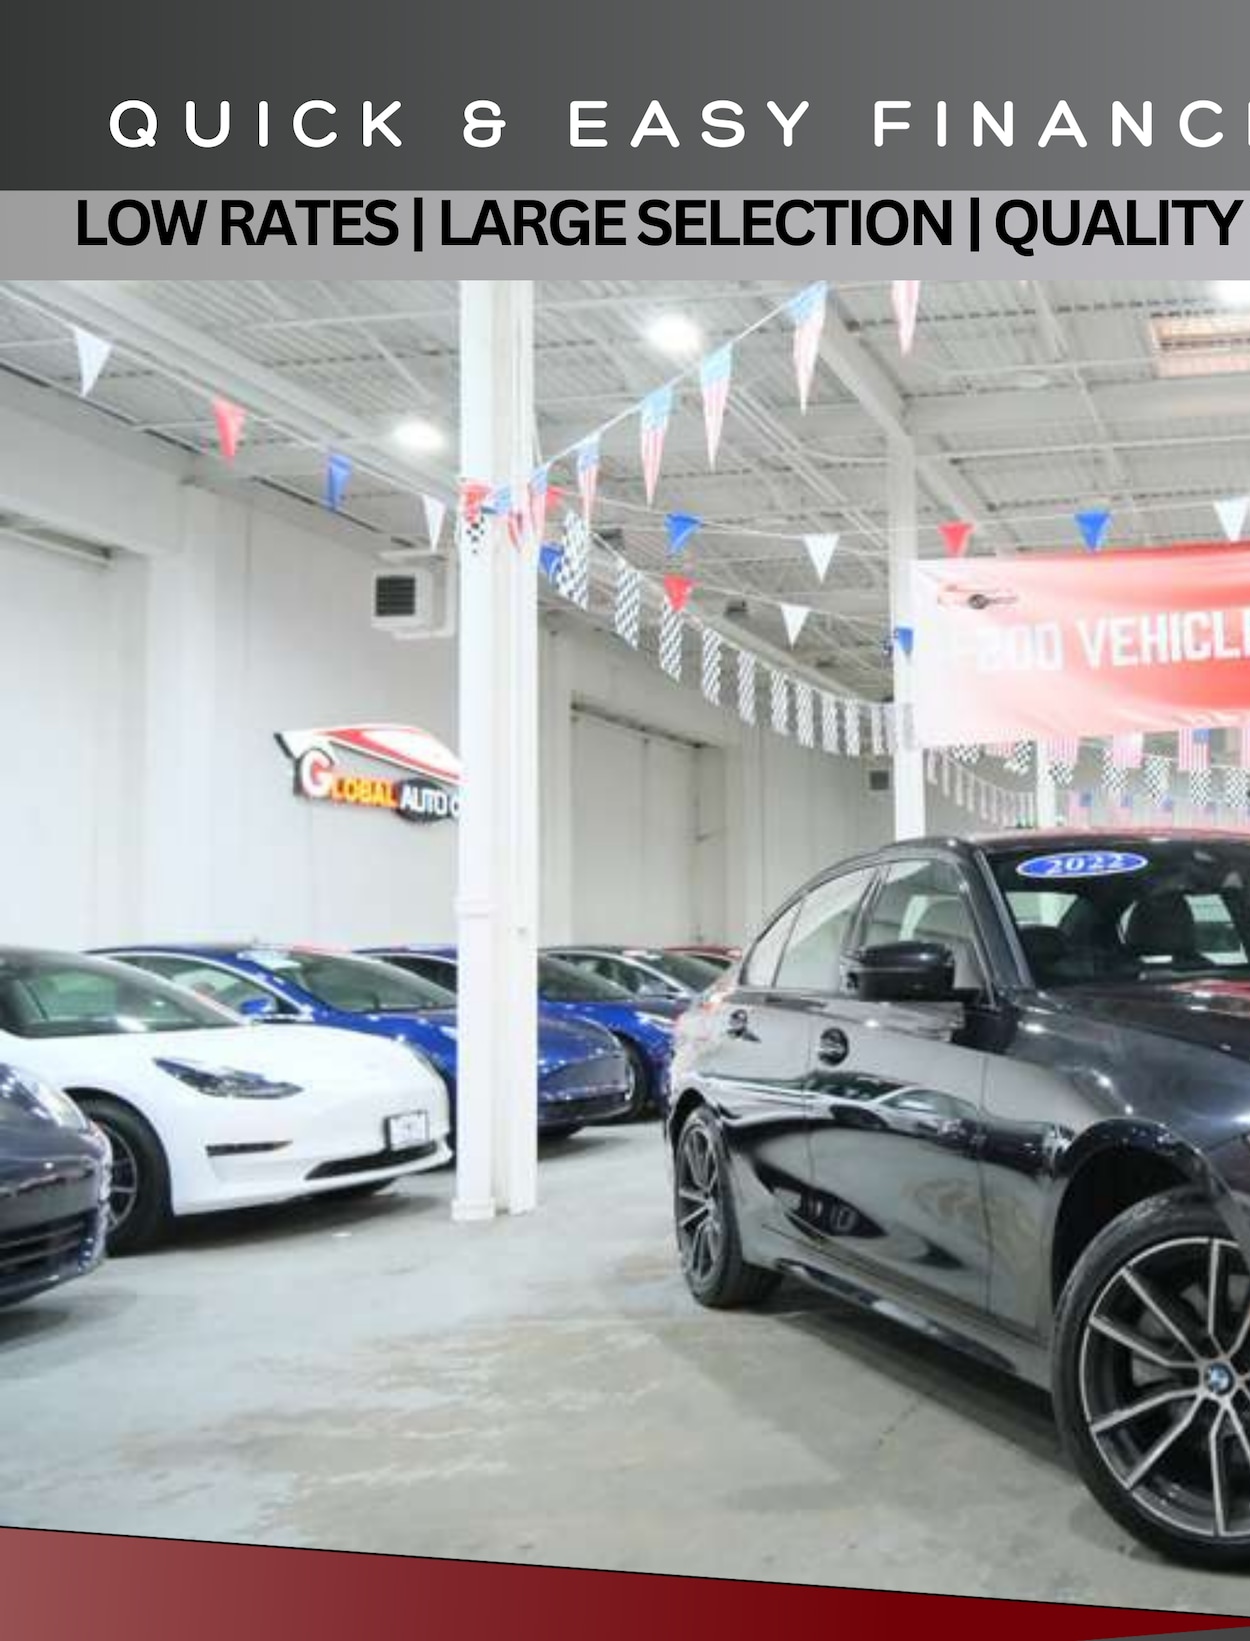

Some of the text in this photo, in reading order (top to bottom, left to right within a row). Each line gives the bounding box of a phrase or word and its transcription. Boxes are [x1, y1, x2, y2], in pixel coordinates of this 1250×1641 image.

[301, 749, 398, 808] GLOBAL
[400, 783, 448, 816] AUTO
[1046, 855, 1127, 876] 2022
